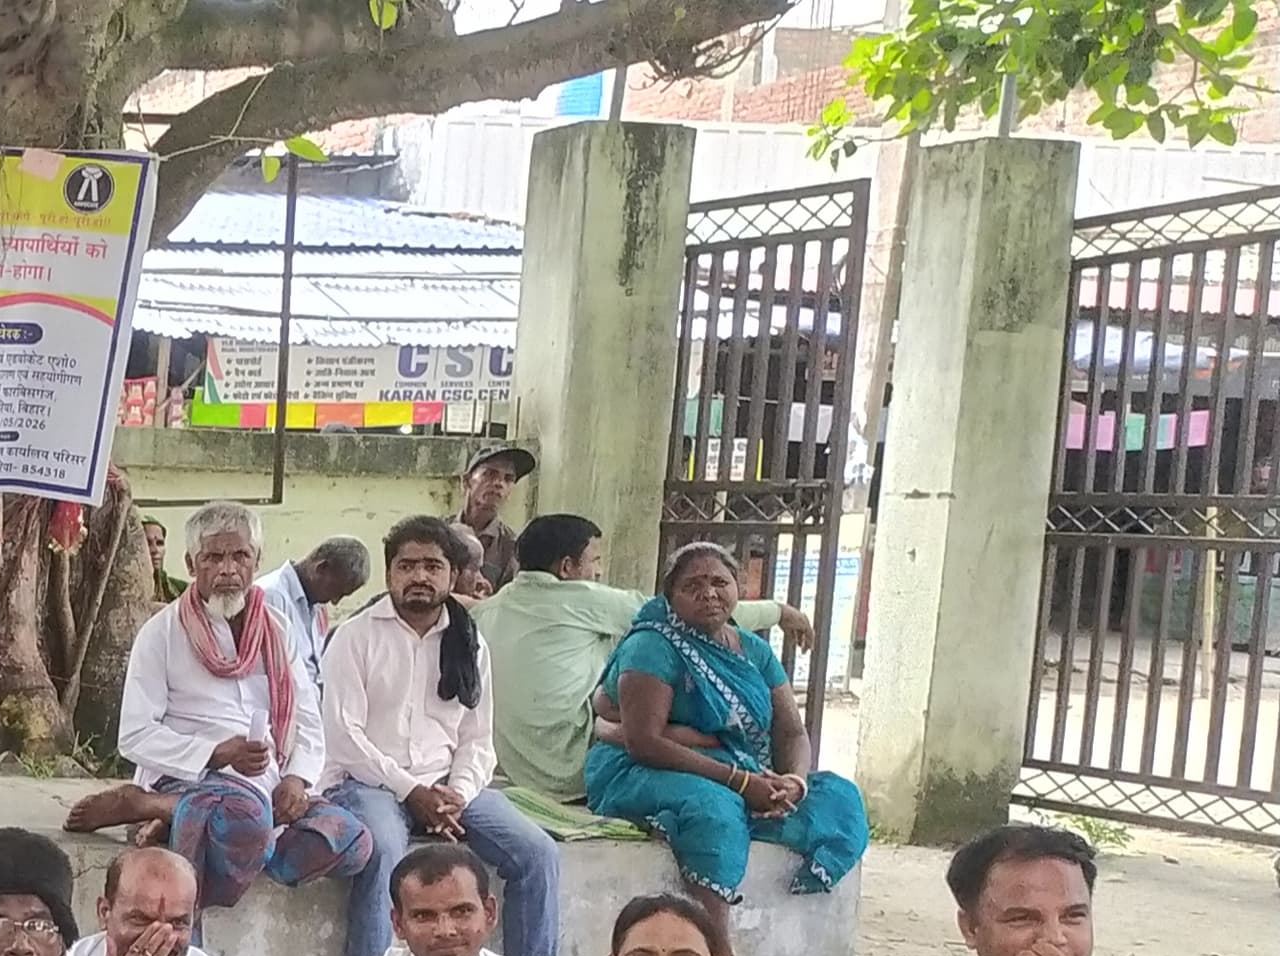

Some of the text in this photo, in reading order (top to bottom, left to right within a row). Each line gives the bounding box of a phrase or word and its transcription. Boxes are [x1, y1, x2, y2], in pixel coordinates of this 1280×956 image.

[85, 238, 108, 260] को
[378, 389, 437, 402] KARAN
[441, 389, 474, 401] CSC
[21, 464, 66, 480] 854318
